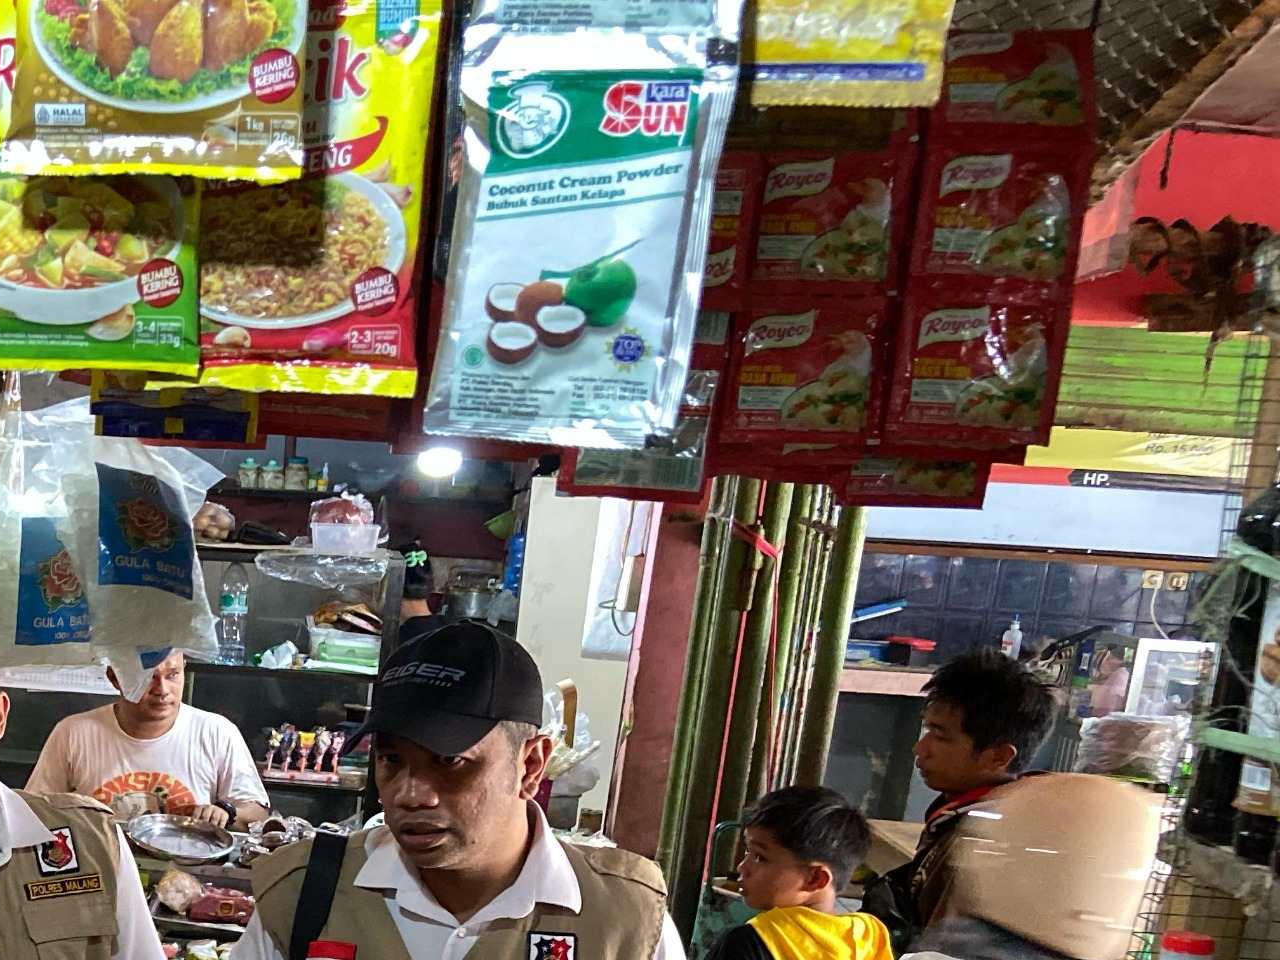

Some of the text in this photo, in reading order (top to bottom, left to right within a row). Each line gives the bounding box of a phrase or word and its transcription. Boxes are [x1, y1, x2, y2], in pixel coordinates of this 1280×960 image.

[253, 55, 293, 79] BUMBU
[255, 67, 295, 89] KERING
[650, 83, 685, 99] kara
[53, 107, 83, 118] HALAL
[599, 80, 690, 142] SUN
[488, 162, 683, 197] Coconut Cream Powder
[486, 187, 626, 211] Bubuk Santan Kelapa
[141, 266, 177, 285] BUMBU
[355, 274, 393, 292] BUMBU
[143, 277, 180, 295] KERING
[357, 286, 395, 304] KERING
[753, 324, 807, 342] Royco
[924, 317, 982, 337] Royco
[374, 344, 397, 357] 20g
[1082, 472, 1111, 487] HP.
[113, 554, 150, 569] GULA
[32, 616, 64, 629] GULA
[383, 661, 468, 682] EIGER
[31, 876, 100, 897] POLRES MALANG
